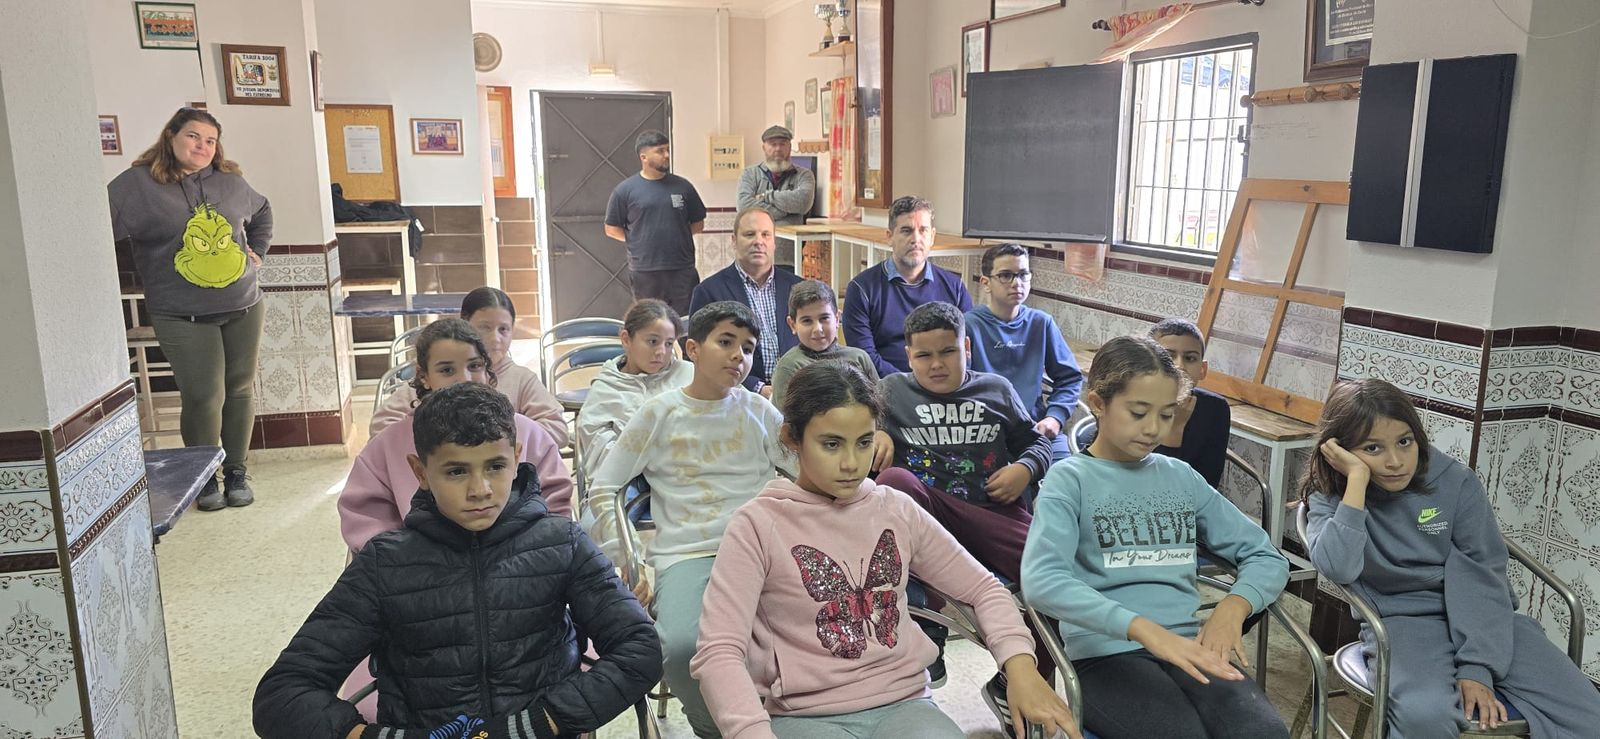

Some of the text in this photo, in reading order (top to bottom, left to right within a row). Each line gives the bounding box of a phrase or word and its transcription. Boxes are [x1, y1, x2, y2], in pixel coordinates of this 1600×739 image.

[915, 401, 985, 425] SPACE
[900, 424, 1000, 446] INVADERS
[1421, 507, 1438, 518] NIKE
[1092, 510, 1196, 549] BELIEVE
[1109, 549, 1192, 566] In Your Dreams
